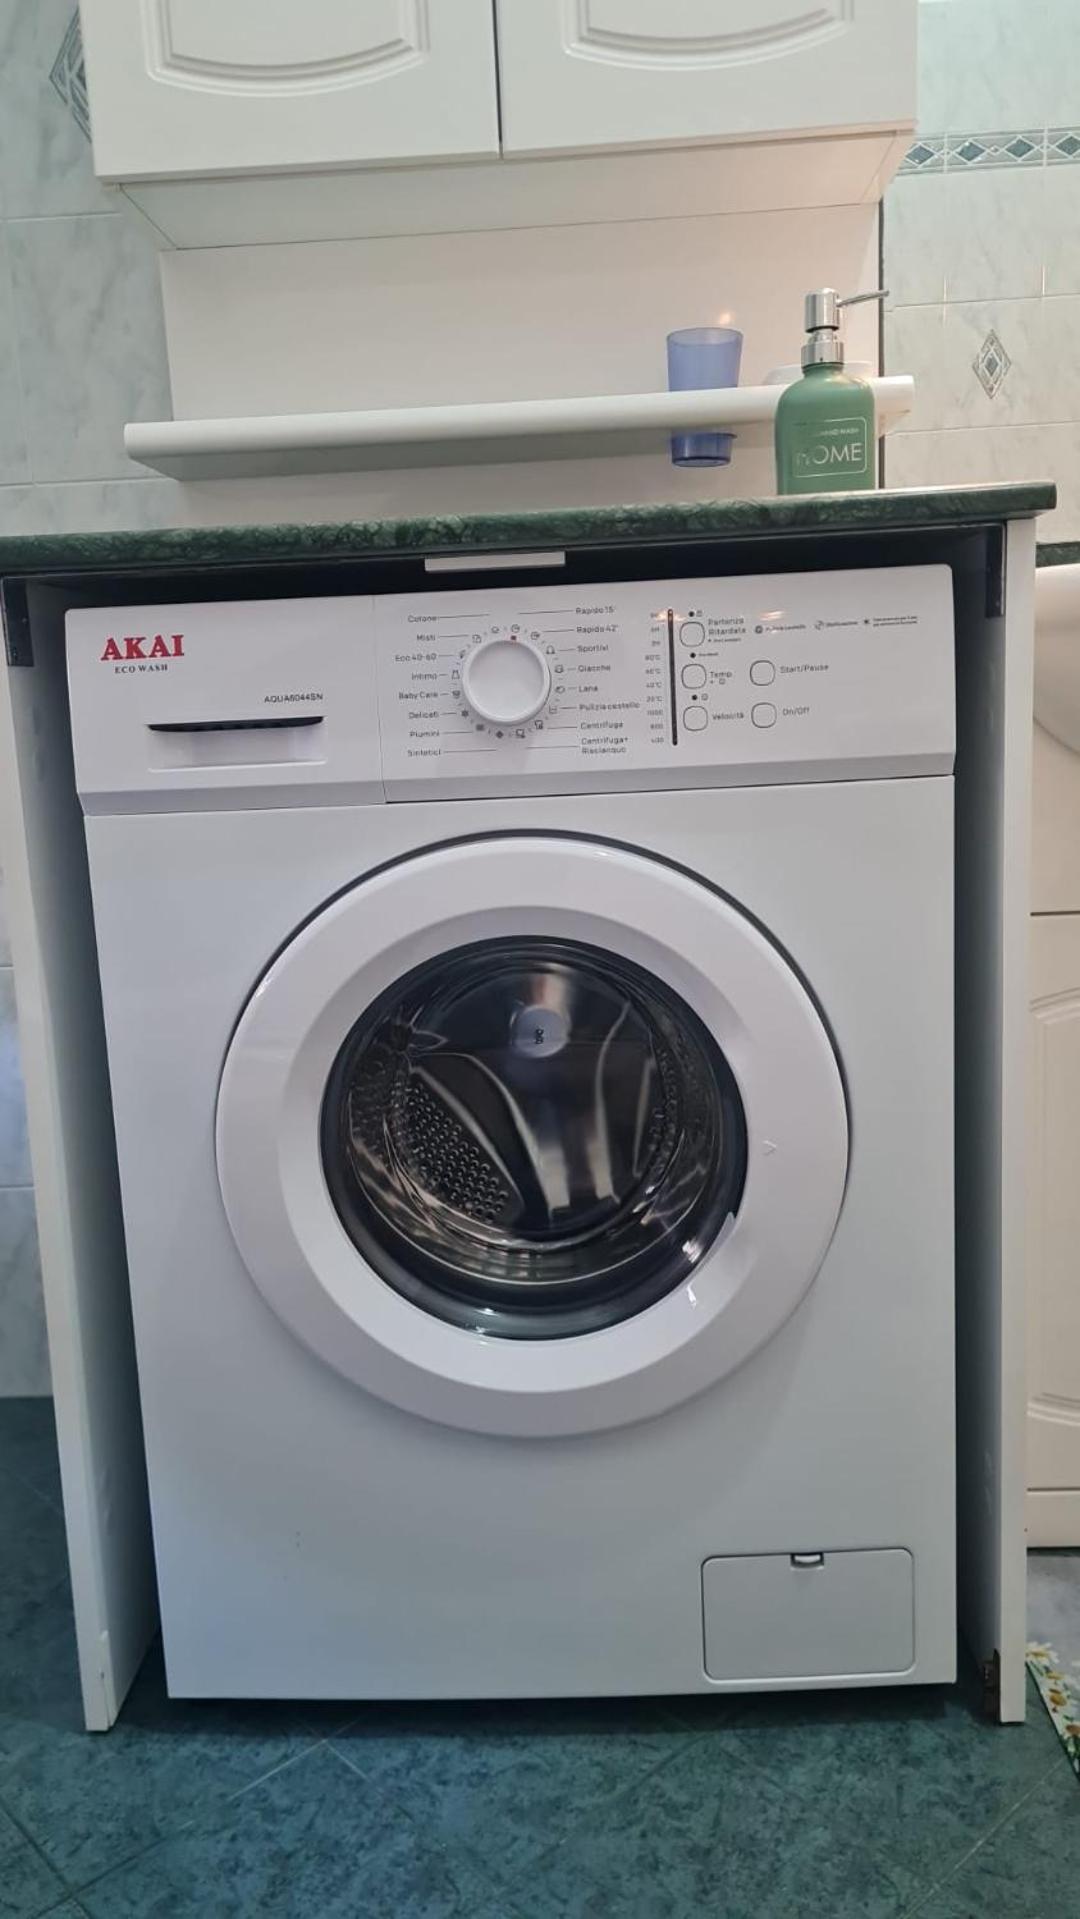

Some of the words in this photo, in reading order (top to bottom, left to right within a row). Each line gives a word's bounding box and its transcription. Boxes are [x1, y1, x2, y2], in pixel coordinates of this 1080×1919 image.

[575, 607, 604, 615] Rapido
[708, 618, 744, 626] Partenza
[576, 626, 604, 634] Rapido
[708, 627, 746, 635] Ritardata
[100, 633, 185, 660] AKAI
[577, 644, 609, 653] Sportivi
[395, 654, 410, 662] Eco
[411, 653, 437, 661] 40-60
[114, 664, 136, 674] ECO
[137, 663, 168, 673] WASH
[578, 665, 611, 673] Giacche
[780, 664, 829, 673] Start/Pause
[411, 672, 437, 680] Intimo
[578, 685, 598, 693] Lana
[264, 693, 324, 704] AQUA6044SN
[398, 692, 418, 700] Baby
[419, 690, 438, 698] Care
[607, 702, 640, 710] cestello
[408, 711, 439, 719] Delicati
[782, 706, 810, 716] On/Off
[580, 722, 623, 730] Centrifuga
[407, 749, 441, 757] Sintetici
[582, 746, 627, 754] Risciacquo
